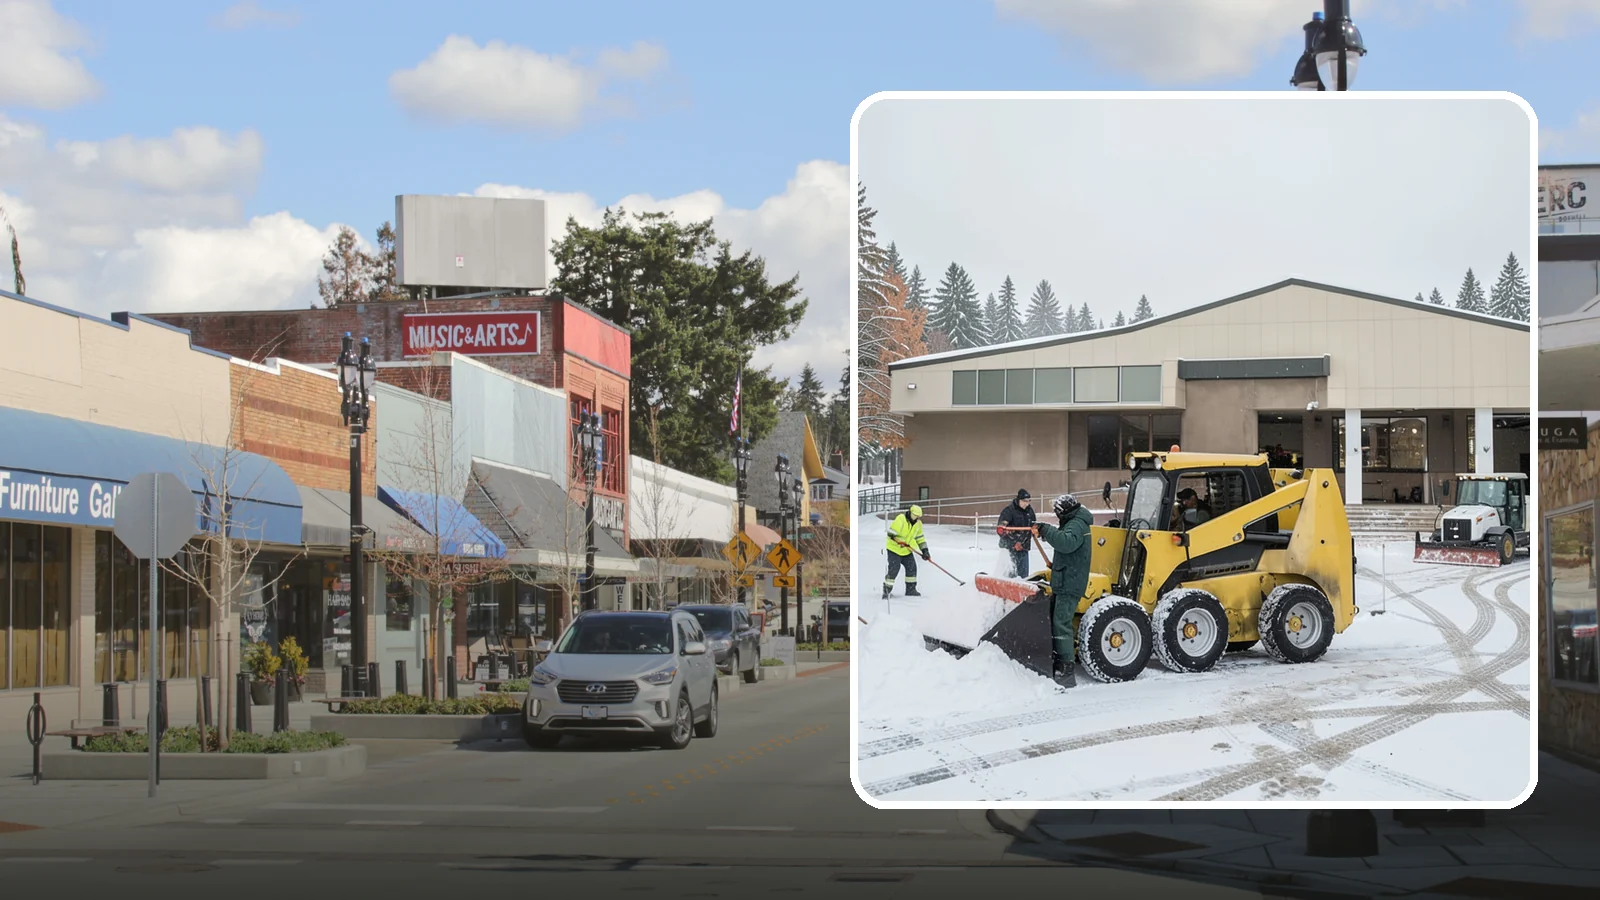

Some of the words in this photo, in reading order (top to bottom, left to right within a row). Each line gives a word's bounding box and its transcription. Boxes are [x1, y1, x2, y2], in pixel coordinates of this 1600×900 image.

[0, 472, 79, 515] Furniture
[90, 483, 121, 518] Gal
[454, 563, 479, 574] SUSHI
